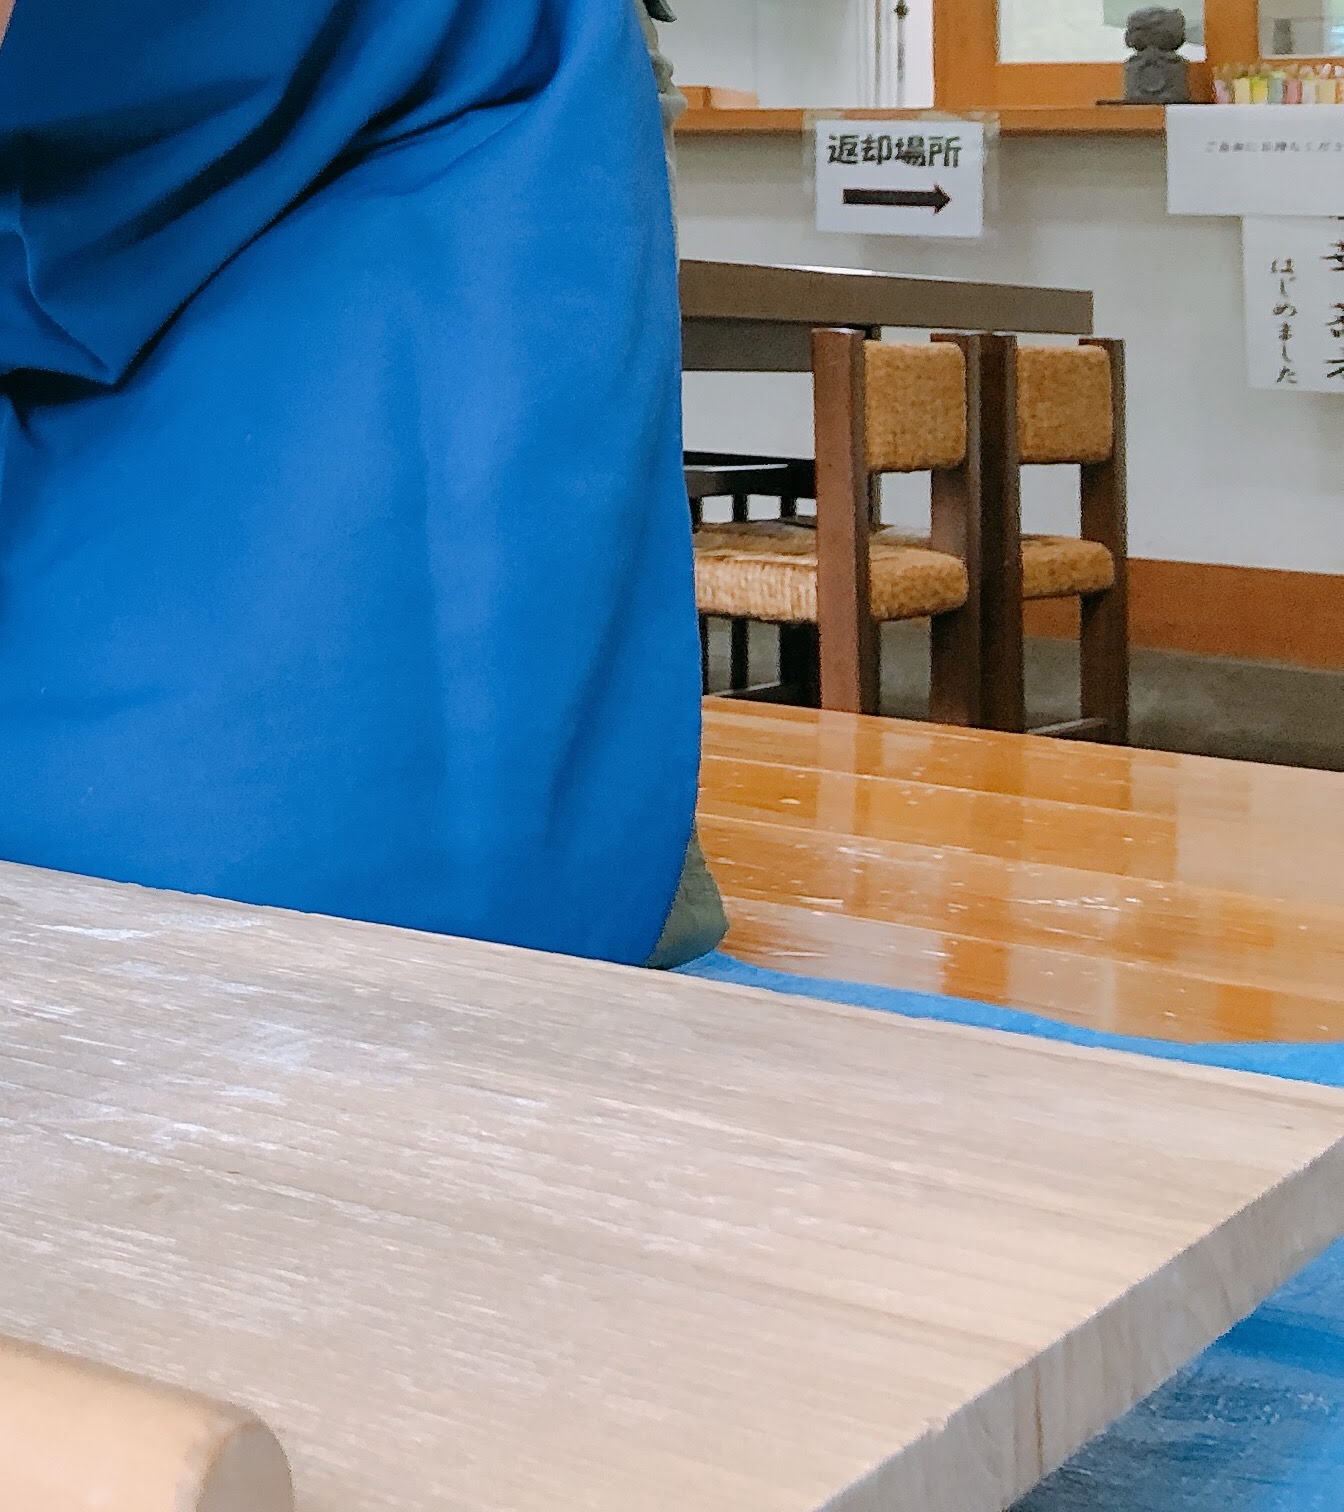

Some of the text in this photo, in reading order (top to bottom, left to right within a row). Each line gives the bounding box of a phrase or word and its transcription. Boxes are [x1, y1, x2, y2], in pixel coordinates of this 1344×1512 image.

[827, 133, 963, 169] 返却場所
[1270, 257, 1298, 384] はじめました
